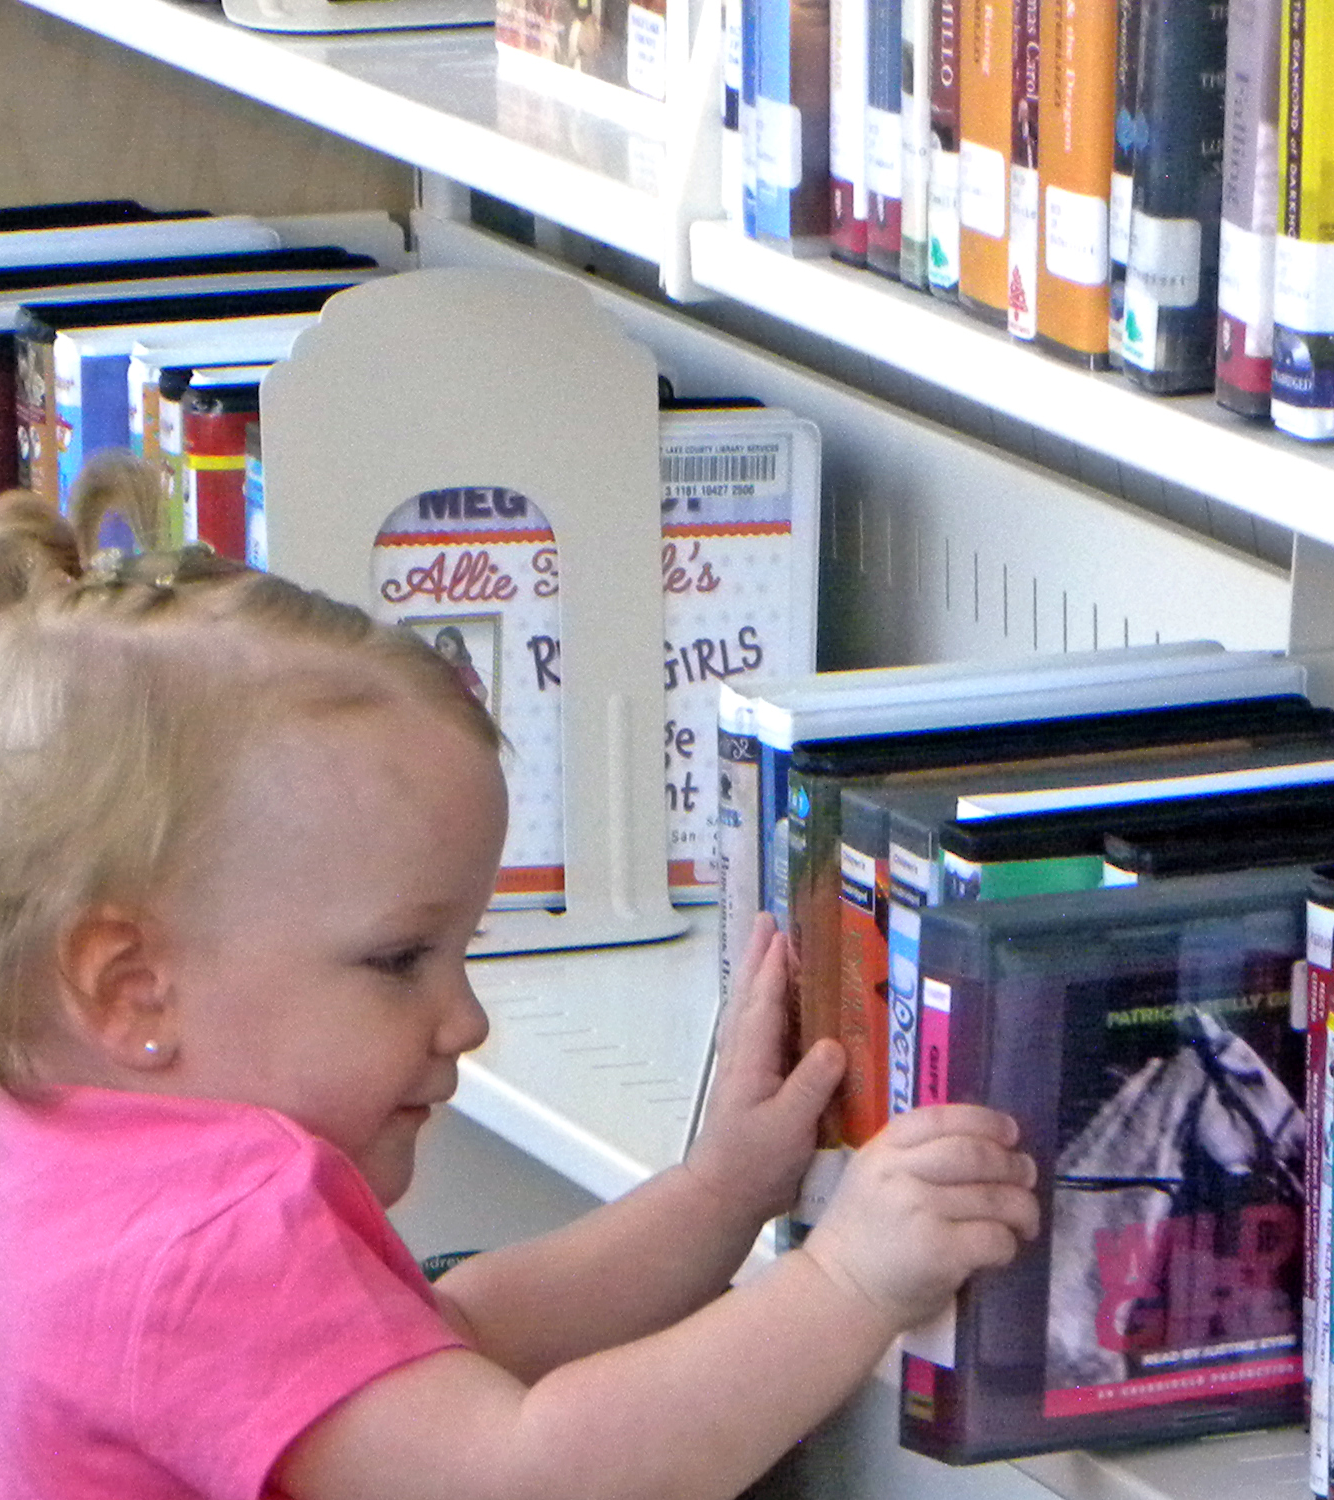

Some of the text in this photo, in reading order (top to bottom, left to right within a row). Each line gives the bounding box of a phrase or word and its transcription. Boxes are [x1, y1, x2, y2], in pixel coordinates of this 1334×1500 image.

[1025, 41, 1040, 101] Carol
[1290, 38, 1303, 132] DIAMOND
[1062, 68, 1076, 153] Dragon
[685, 445, 713, 454] COUNTY
[715, 445, 745, 454] LIBRARY
[418, 488, 527, 520] MEG
[380, 550, 519, 605] Allie
